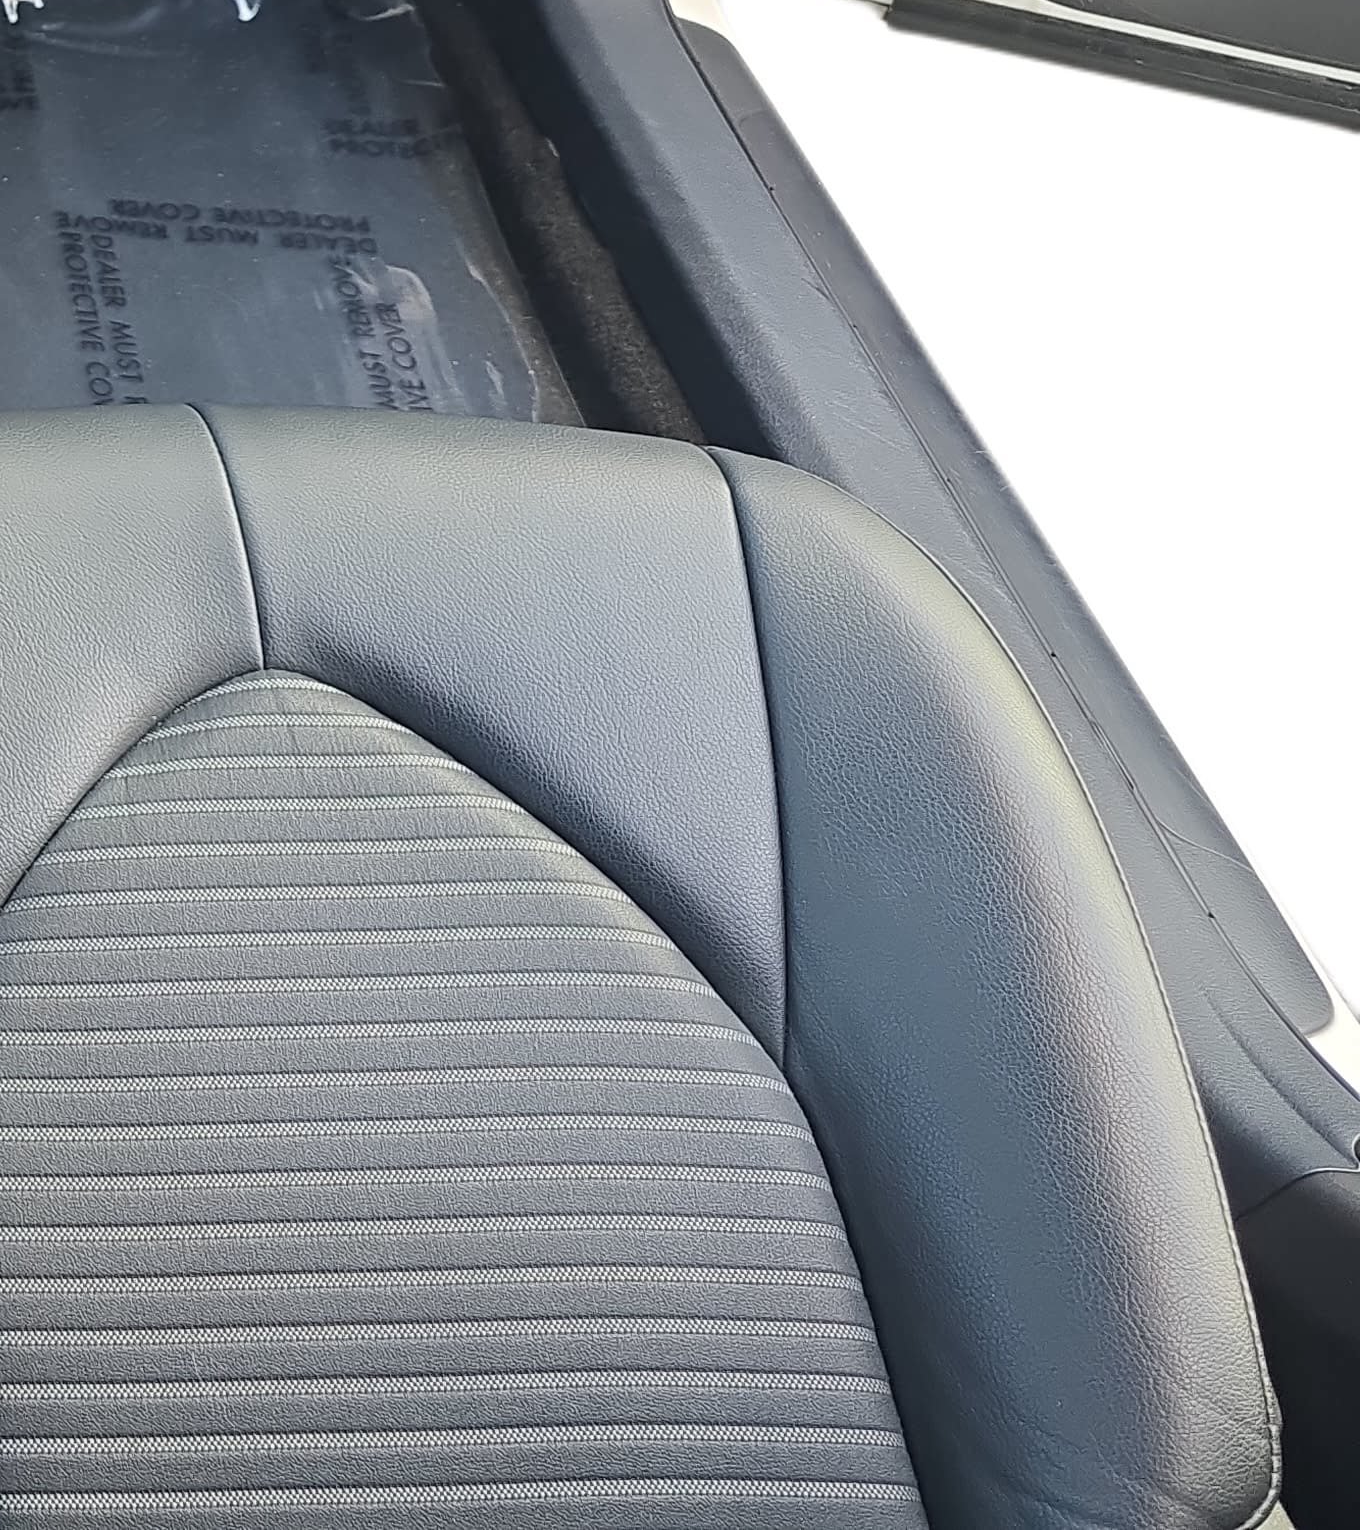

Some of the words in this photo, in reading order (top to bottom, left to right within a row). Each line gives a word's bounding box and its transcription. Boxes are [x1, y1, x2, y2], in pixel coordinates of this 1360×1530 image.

[109, 198, 201, 222] COVER
[214, 206, 370, 234] PROTECTIVE
[184, 225, 259, 246] MUST
[89, 234, 128, 309] DEALER
[109, 320, 144, 384] MUST
[375, 302, 420, 374] COVER
[85, 361, 115, 406] COV
